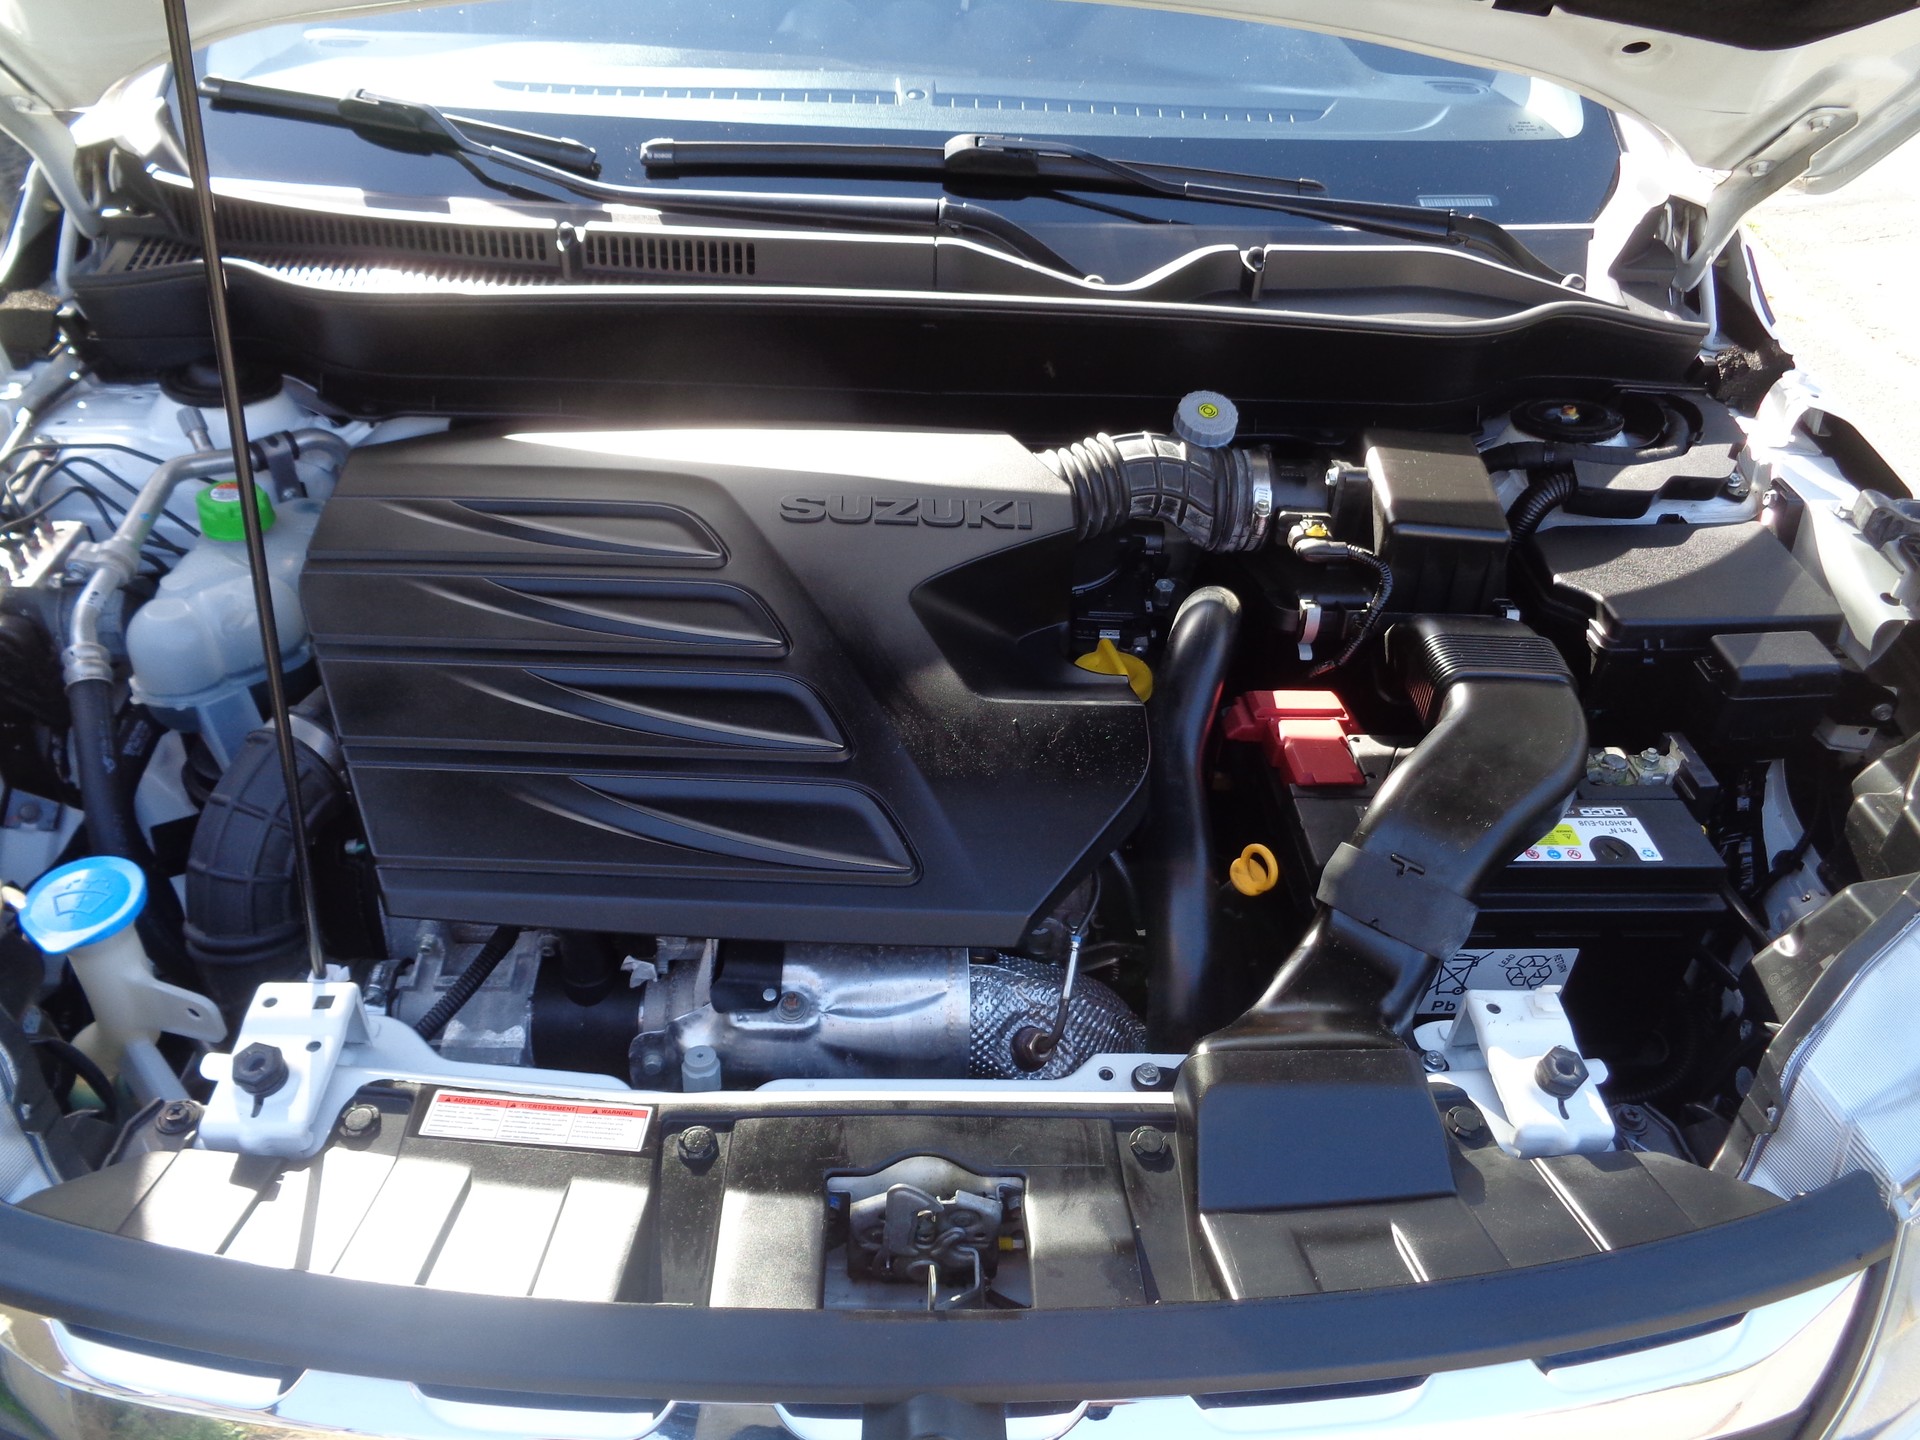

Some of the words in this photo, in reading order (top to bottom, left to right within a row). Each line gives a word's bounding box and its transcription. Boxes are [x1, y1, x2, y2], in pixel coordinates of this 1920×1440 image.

[780, 494, 1033, 529] SUZUKI
[1498, 953, 1516, 968] LEAD
[1554, 953, 1568, 973] RETURN
[1431, 1000, 1456, 1012] Pb
[453, 1097, 500, 1106] ADVERTENCIA
